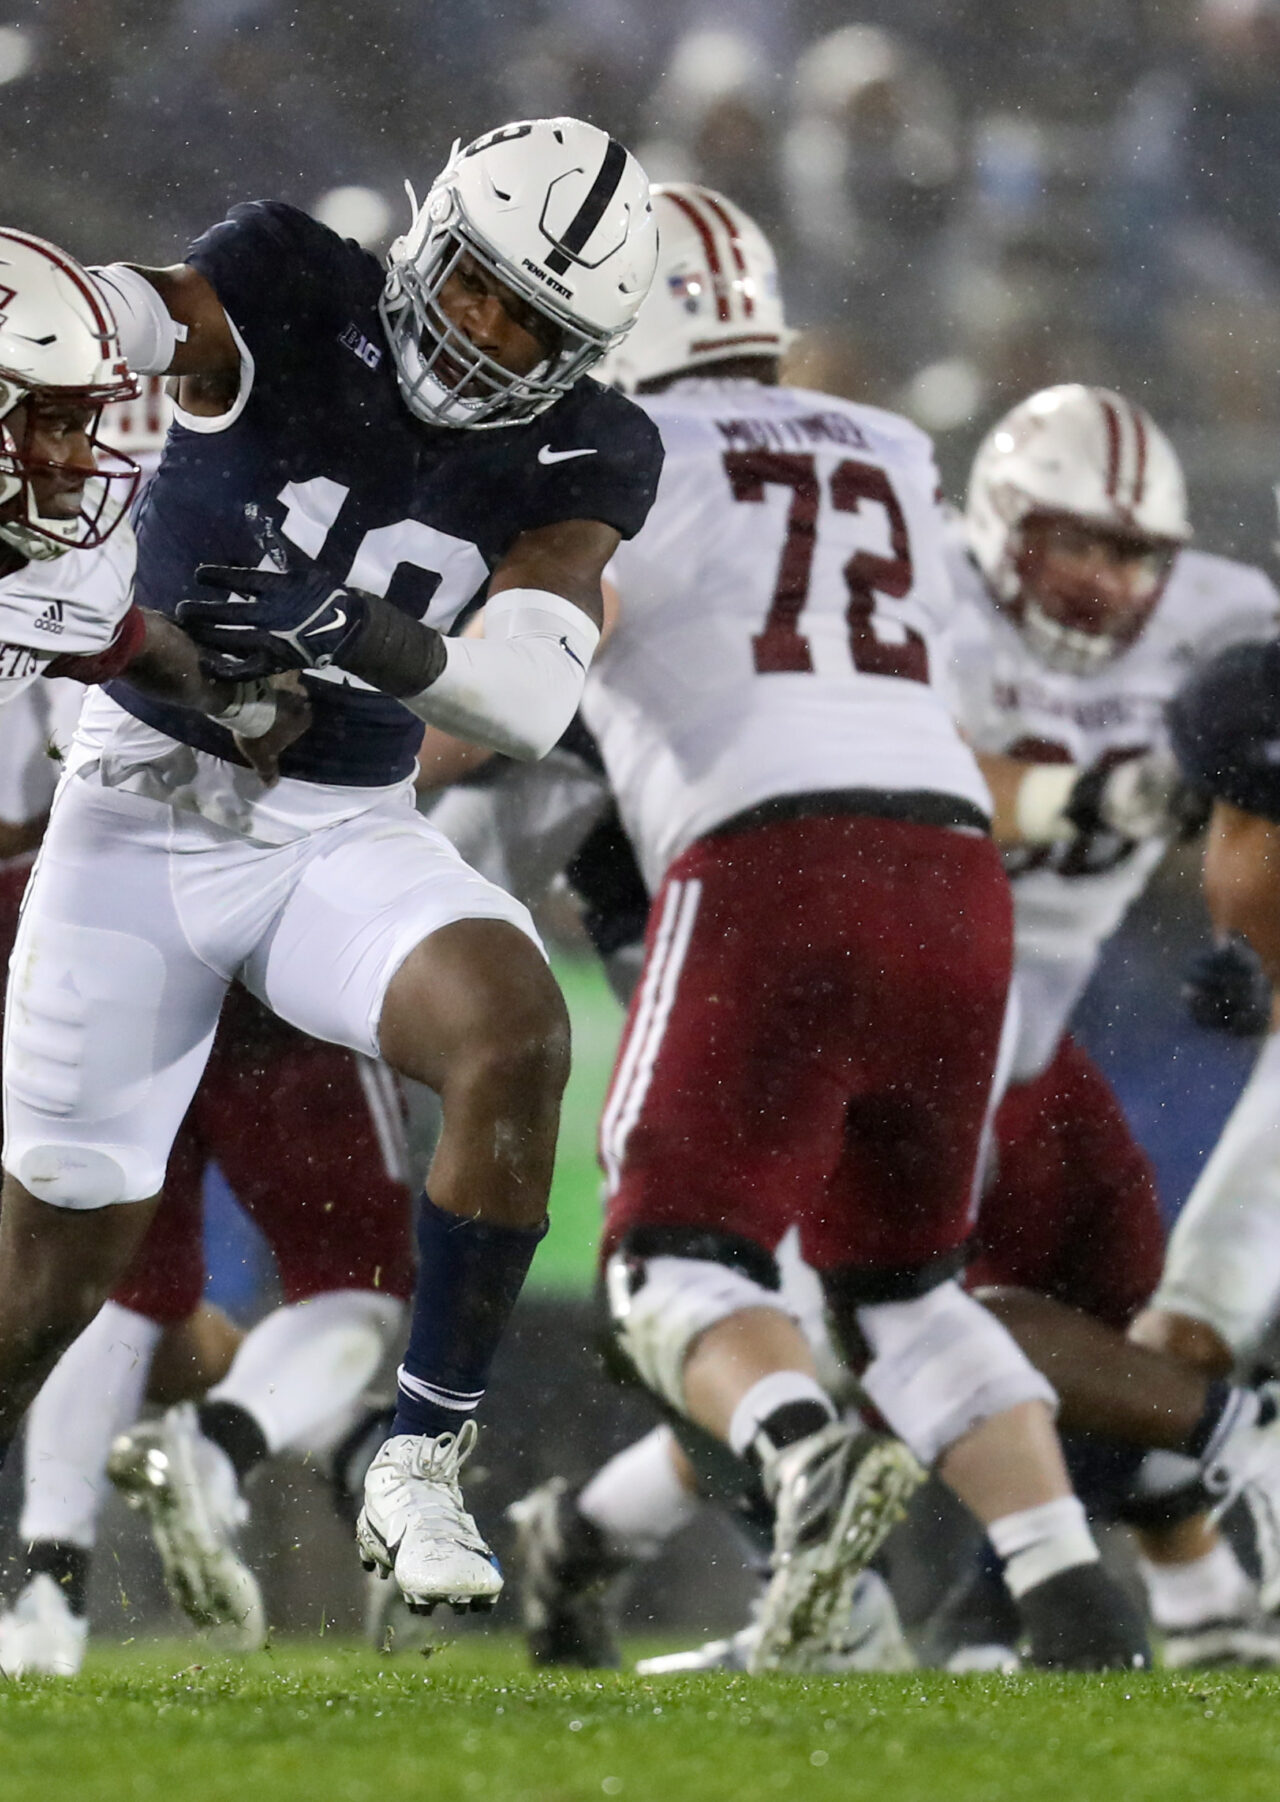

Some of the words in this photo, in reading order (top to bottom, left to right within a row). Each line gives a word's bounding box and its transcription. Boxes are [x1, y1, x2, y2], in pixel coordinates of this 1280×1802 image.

[522, 258, 547, 281] PENN
[546, 277, 574, 300] STATE
[721, 451, 931, 686] 72
